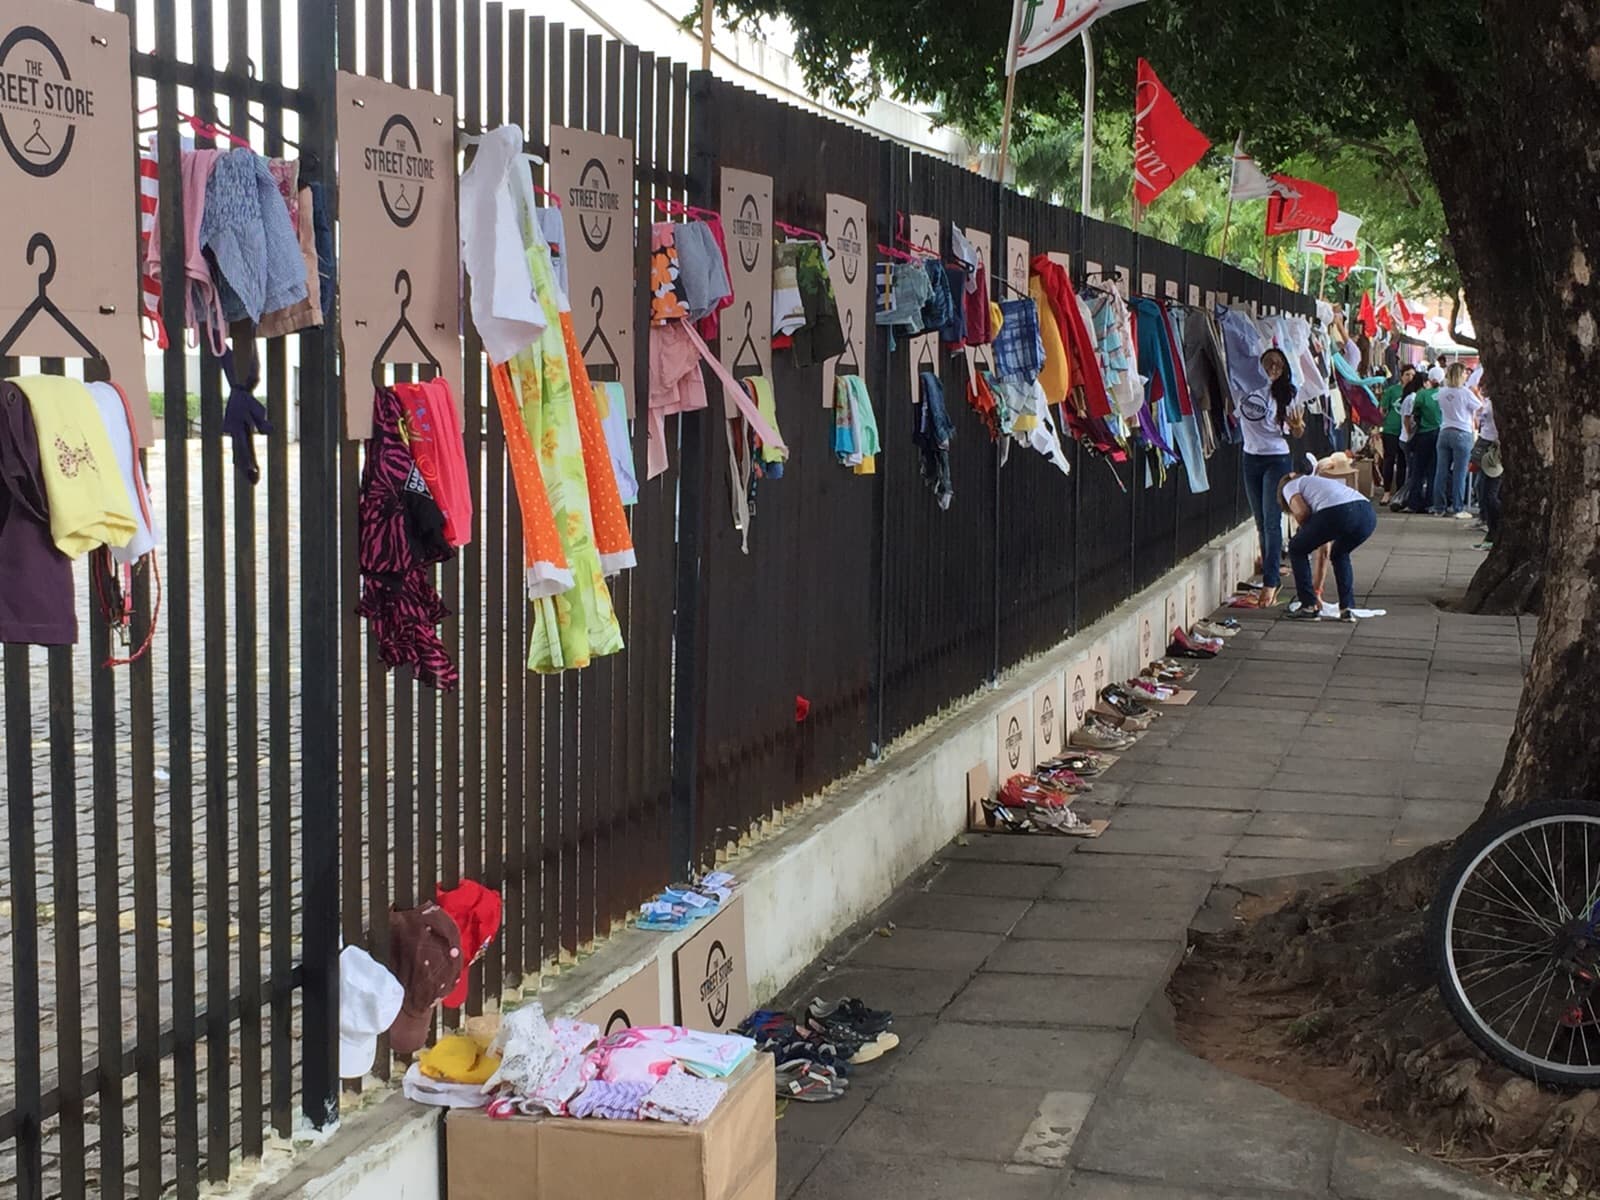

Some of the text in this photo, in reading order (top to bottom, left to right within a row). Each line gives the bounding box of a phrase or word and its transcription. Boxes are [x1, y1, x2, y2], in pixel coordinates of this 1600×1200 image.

[25, 59, 43, 77] THE
[44, 82, 94, 117] STORE
[364, 147, 435, 180] STREET STORE
[569, 188, 598, 208] STREET
